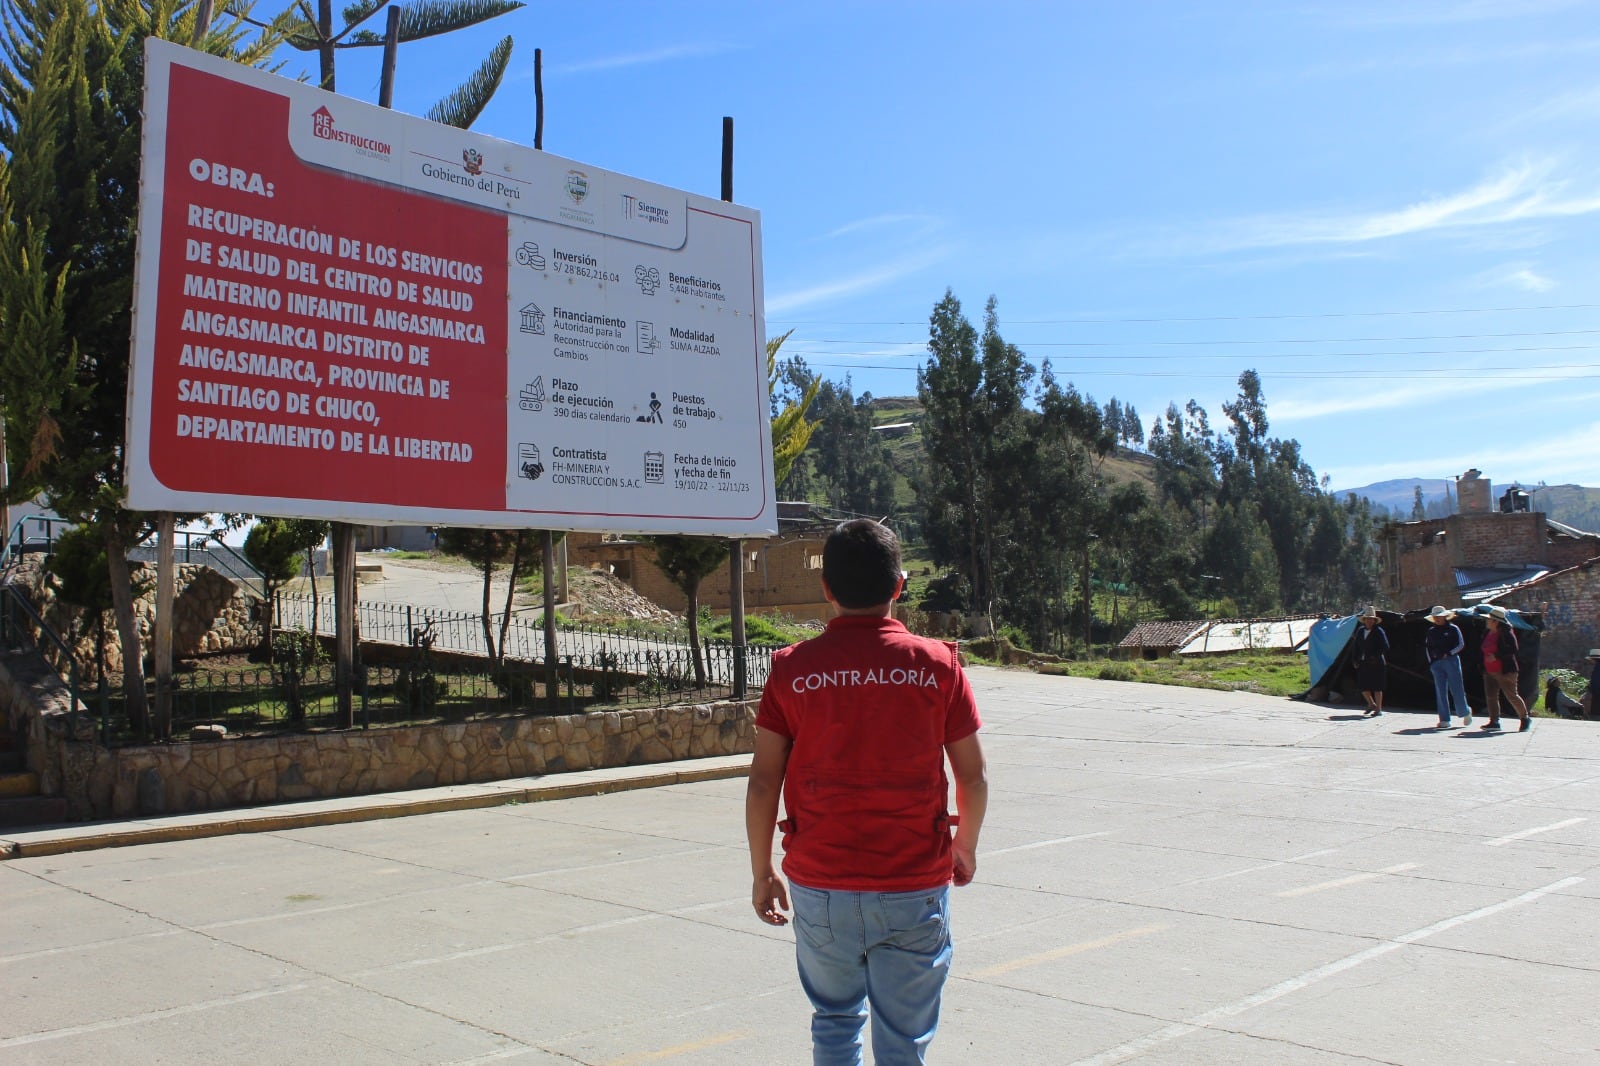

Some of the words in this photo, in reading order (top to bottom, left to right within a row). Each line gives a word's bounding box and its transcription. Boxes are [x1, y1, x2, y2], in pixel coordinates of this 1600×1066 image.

[189, 158, 275, 198] OBRA:
[421, 163, 475, 188] Gobierno
[477, 175, 493, 193] del
[497, 183, 520, 200] Perú
[639, 202, 669, 217] Siempre
[649, 215, 669, 224] pueblo
[188, 203, 332, 255] RECUPERACIÓN
[338, 237, 360, 260] DE
[366, 243, 396, 267] LOS
[401, 250, 482, 284] SERVICIOS
[553, 248, 597, 267] Inversión
[186, 239, 212, 264] DE
[218, 245, 280, 277] SALUD
[287, 260, 319, 284] DEL
[325, 266, 391, 297] CENTRO
[397, 281, 417, 303] DE
[422, 286, 472, 311] SALUD
[554, 262, 562, 273] S/
[669, 272, 721, 291] Beneficiarios
[691, 288, 725, 301] habitantes
[184, 274, 281, 310] MATERNO
[287, 292, 368, 325] INFANTIL
[373, 308, 485, 344] ANGASMARCA
[553, 307, 626, 328] Financiamiento
[554, 320, 594, 334] Autoridad
[596, 328, 613, 337] para
[615, 329, 621, 338] la
[670, 327, 714, 343] Modalidad
[181, 309, 317, 349] ANGASMARCA
[323, 331, 403, 363] DISTRITO
[409, 344, 429, 366] DE
[554, 334, 614, 351] Reconstrucción
[616, 344, 629, 353] con
[554, 348, 589, 361] Cambios
[670, 341, 691, 351] SUMA
[694, 345, 720, 356] ALZADA
[179, 344, 322, 387] ANGASMARCA,
[329, 365, 424, 396] PROVINCIA
[429, 378, 449, 399] DE
[552, 378, 578, 391] Plazo
[178, 379, 279, 411] SANTIAGO
[286, 393, 309, 415] DE
[316, 395, 381, 426] CHUCO,
[552, 392, 564, 404] de
[568, 394, 613, 408] ejecución
[672, 392, 705, 405] Puestos
[553, 407, 569, 417] 390
[590, 412, 631, 423] calendario
[673, 405, 683, 415] de
[686, 406, 715, 420] trabajo
[673, 420, 687, 428] 450
[177, 414, 335, 450] DEPARTAMENTO
[341, 431, 363, 453] DE
[369, 434, 389, 455] LA
[395, 437, 472, 462] LIBERTAD
[553, 446, 607, 460] Contratista
[674, 453, 699, 465] Fecha
[701, 455, 711, 466] de
[714, 457, 736, 467] Inicio
[605, 466, 609, 474] Y
[675, 468, 679, 478] y
[682, 466, 705, 477] fecha
[707, 468, 718, 478] de
[721, 469, 730, 479] fin
[552, 474, 617, 487] CONSTRUCCION
[620, 479, 641, 488] S.A.C.
[675, 480, 708, 491] 19/10/22
[718, 482, 749, 493] 12/11/23
[792, 667, 938, 693] CONTRALORÍA
